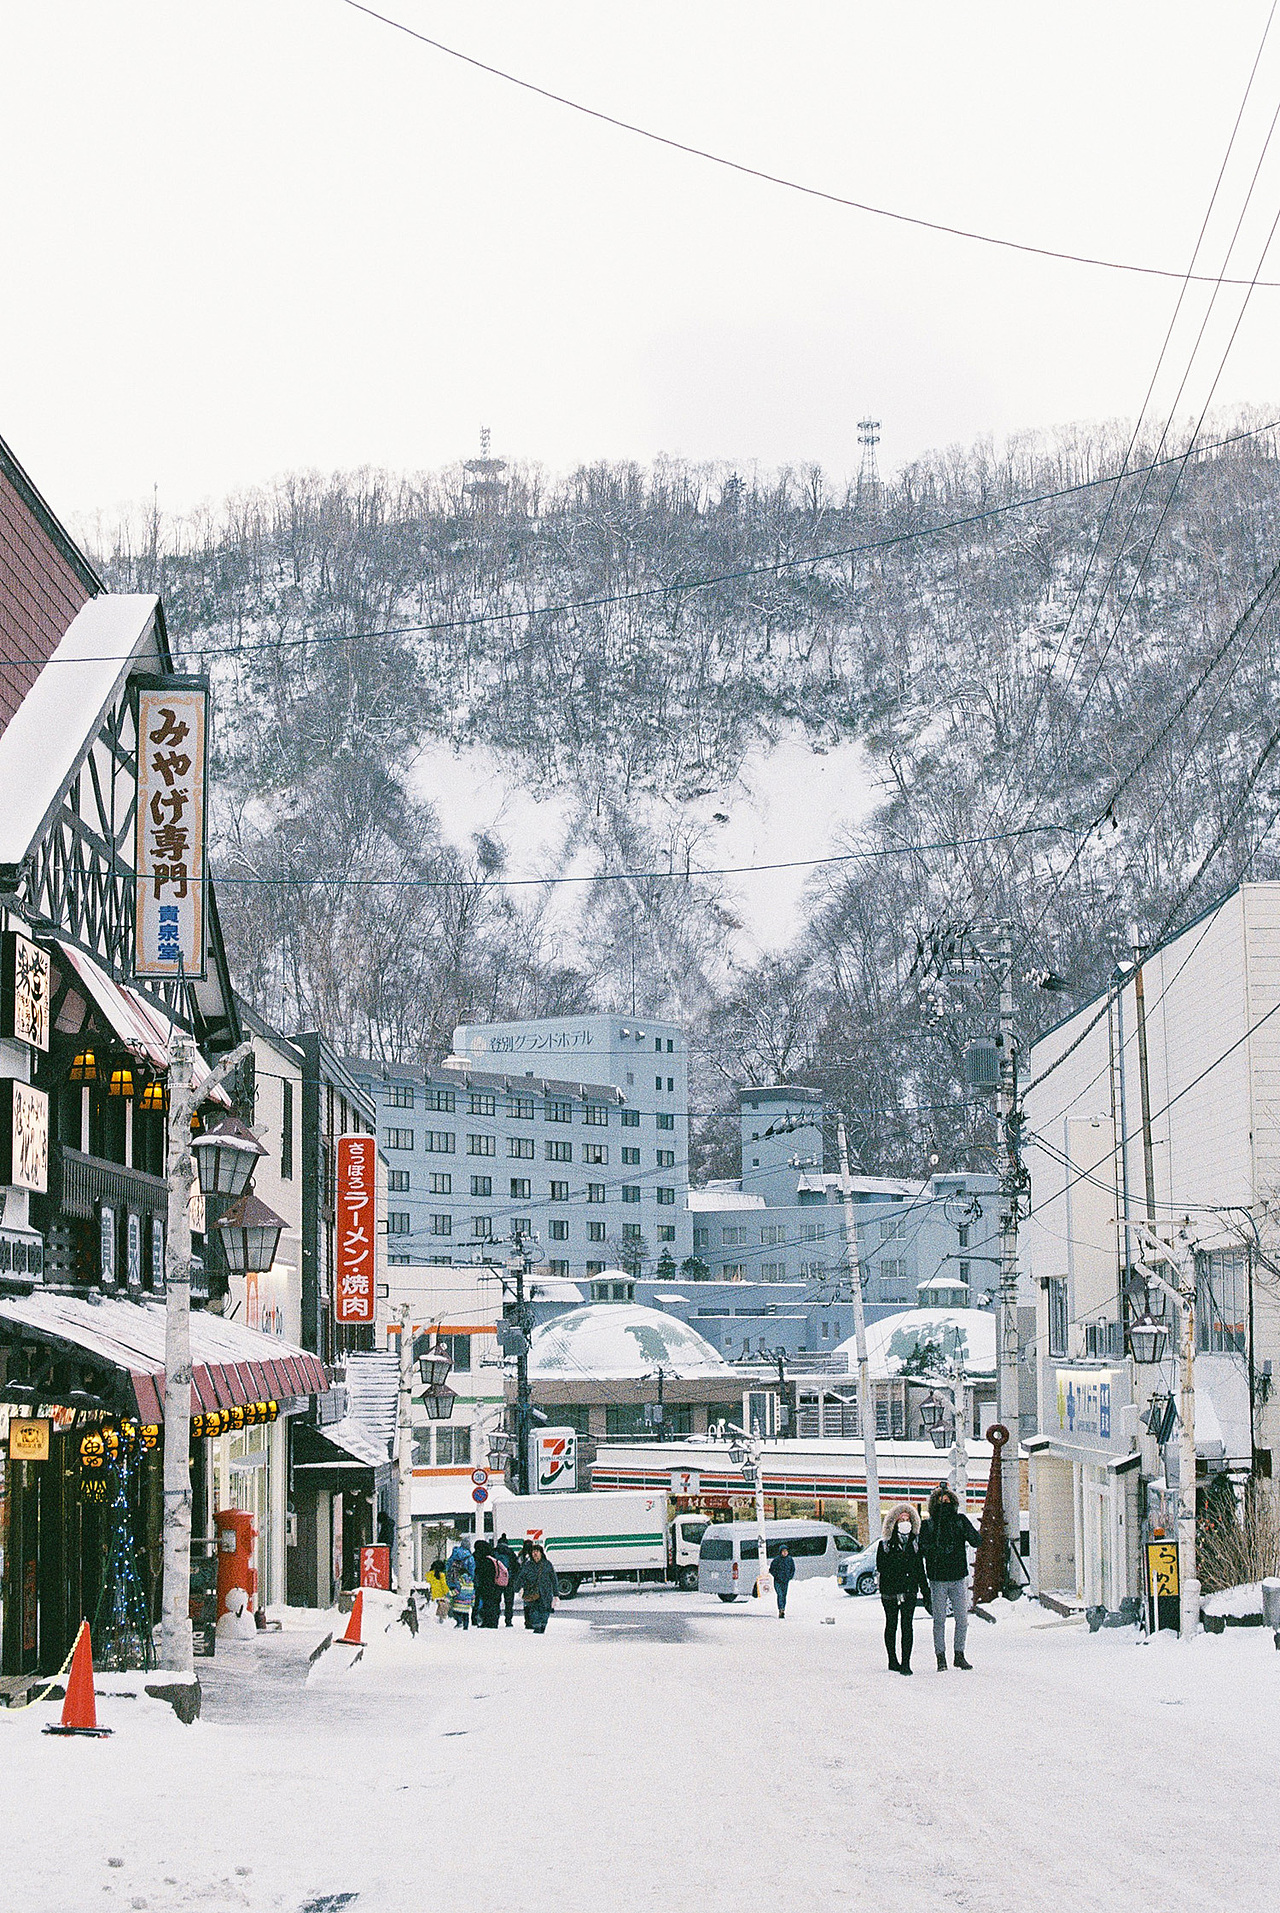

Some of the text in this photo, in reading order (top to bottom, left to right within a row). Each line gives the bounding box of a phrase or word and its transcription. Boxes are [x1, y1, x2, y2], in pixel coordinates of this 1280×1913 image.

[149, 707, 192, 900] みやげ専門
[157, 905, 180, 961] 貴泉堂
[490, 1031, 594, 1052] 登別グランドホテル
[341, 1142, 369, 1317] さっぽろラーメン・焼肉
[475, 1473, 485, 1482] 30
[1152, 1547, 1176, 1595] らーめん
